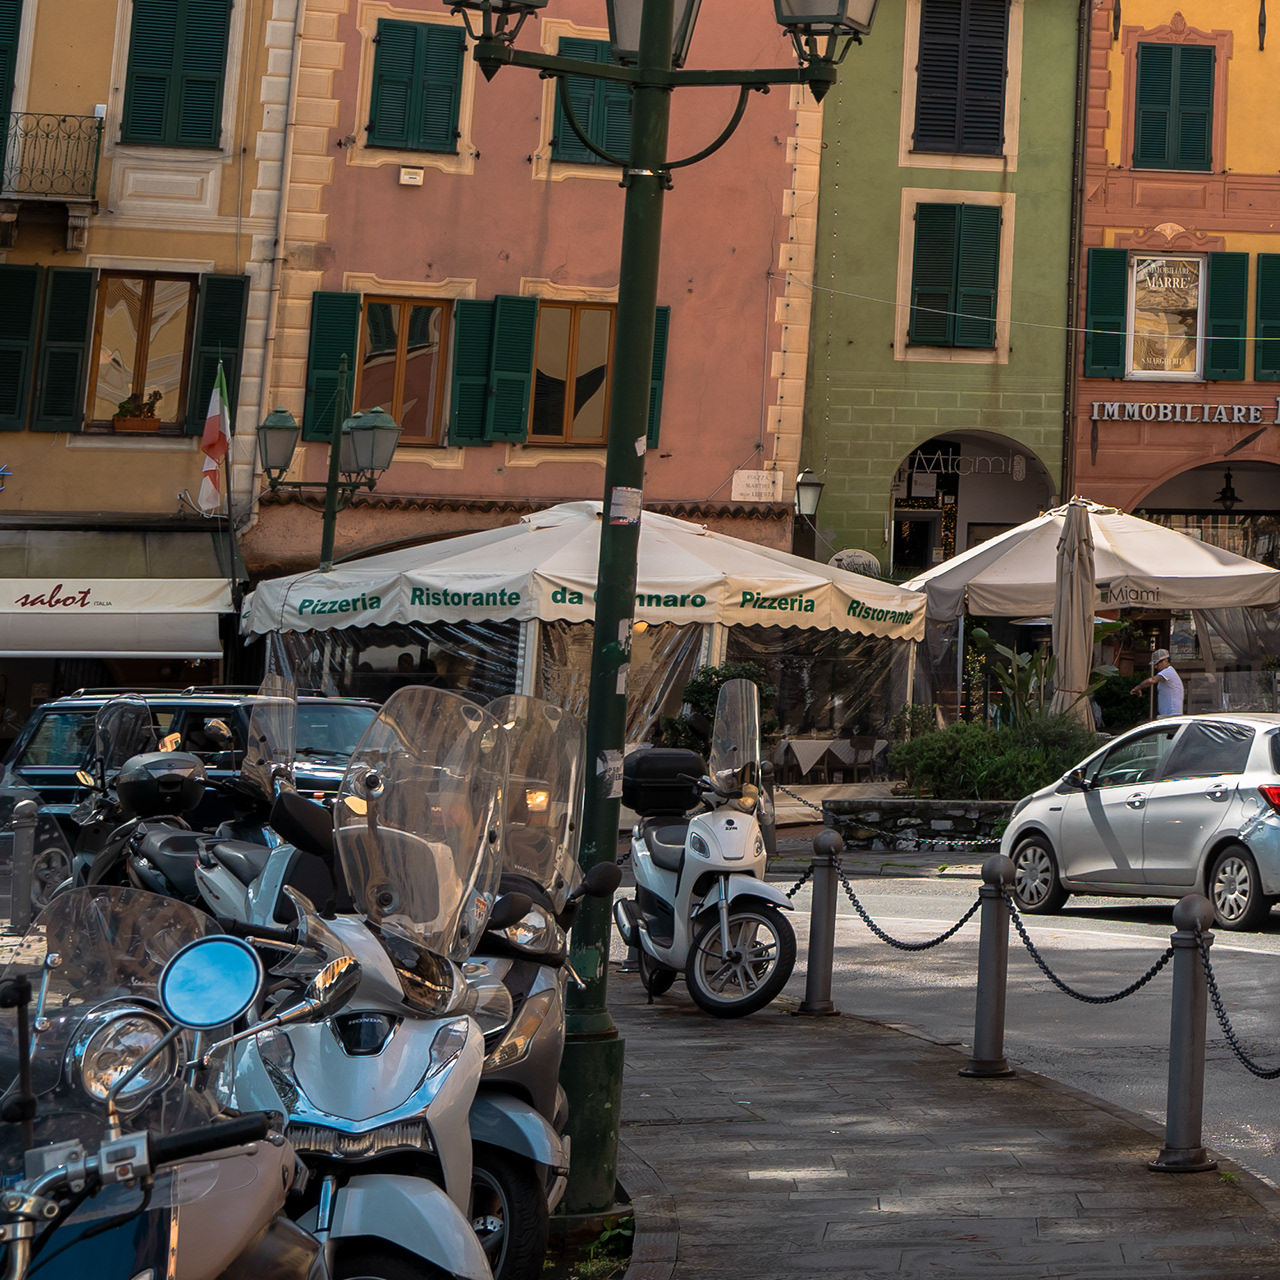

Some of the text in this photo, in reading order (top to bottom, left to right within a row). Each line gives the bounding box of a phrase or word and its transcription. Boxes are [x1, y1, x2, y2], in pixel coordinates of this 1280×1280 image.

[1091, 402, 1263, 424] IMMOBILIARE
[913, 448, 1012, 476] Miami
[15, 583, 92, 608] sabot
[298, 593, 382, 616] Pizzeria
[410, 587, 521, 607] Ristorante
[551, 587, 707, 608] da nnaro
[739, 591, 816, 613] Pizzeria
[1109, 586, 1161, 603] Miami
[847, 599, 914, 625] Ristorante
[348, 1017, 383, 1026] HONDA
